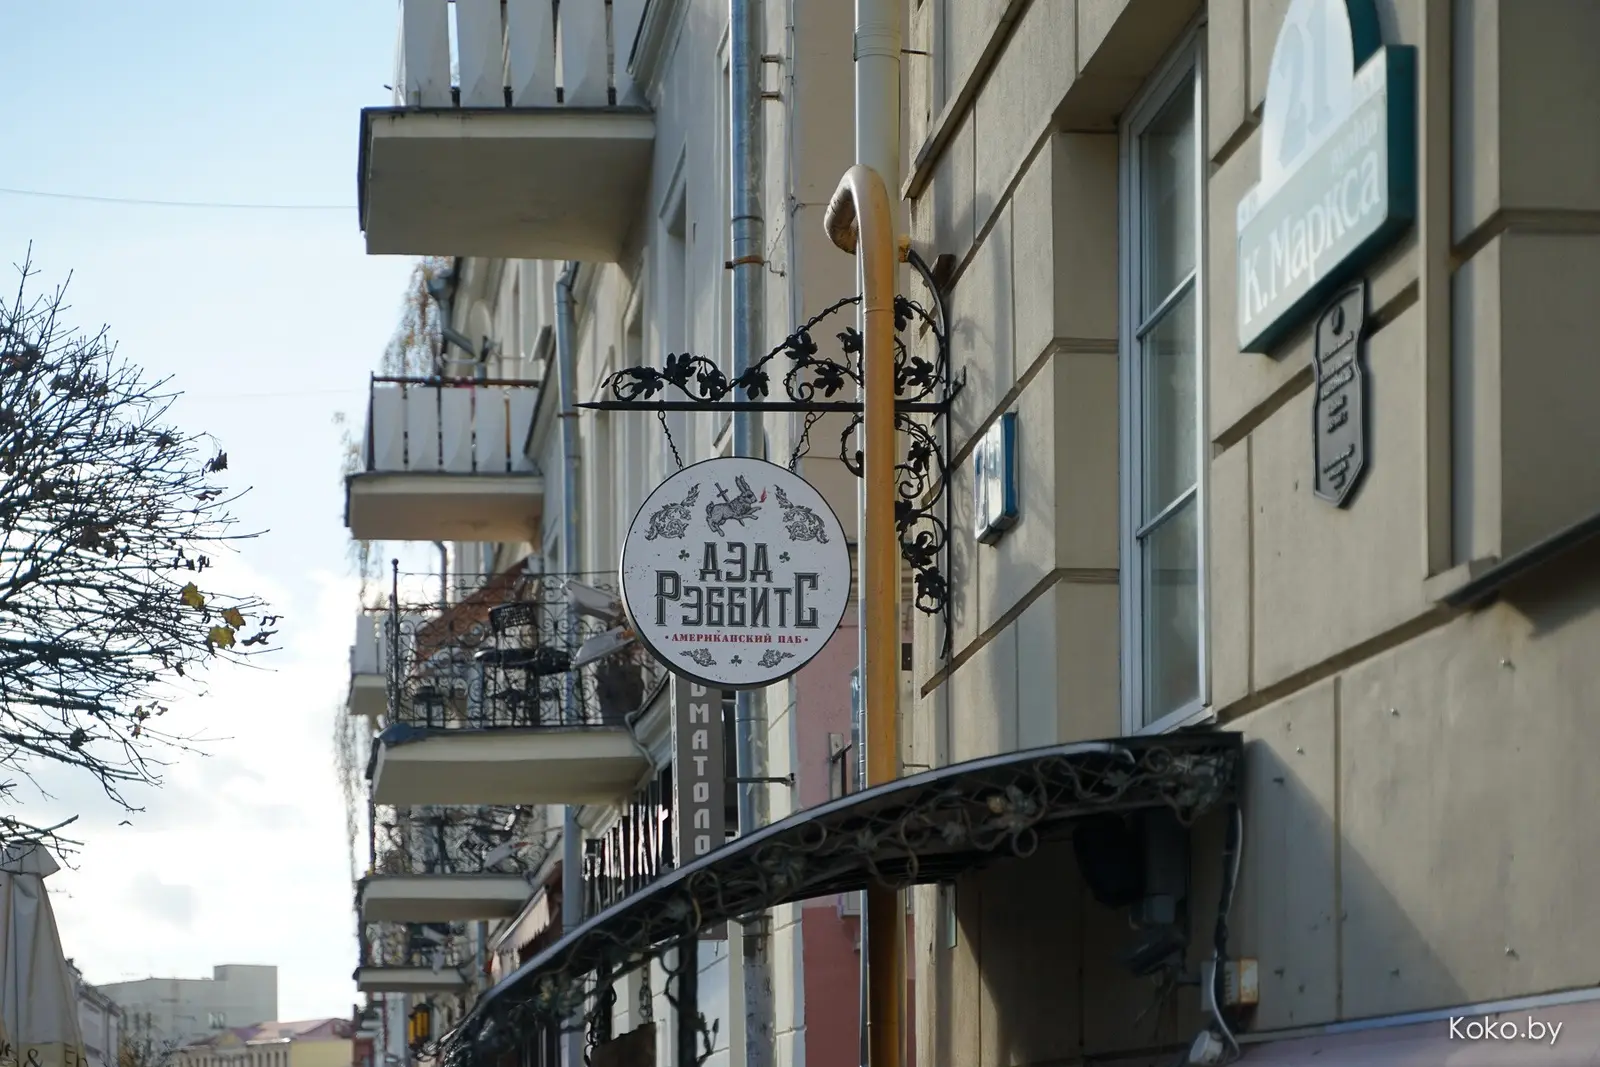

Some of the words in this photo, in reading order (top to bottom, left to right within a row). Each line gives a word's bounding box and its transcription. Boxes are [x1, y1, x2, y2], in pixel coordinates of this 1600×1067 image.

[1276, 2, 1334, 169] 21
[1243, 150, 1381, 325] К.Маркса
[699, 541, 774, 583] ДЭД
[671, 633, 772, 644] АМЕРИКАНСКИЙ
[778, 634, 802, 644] ПАБ
